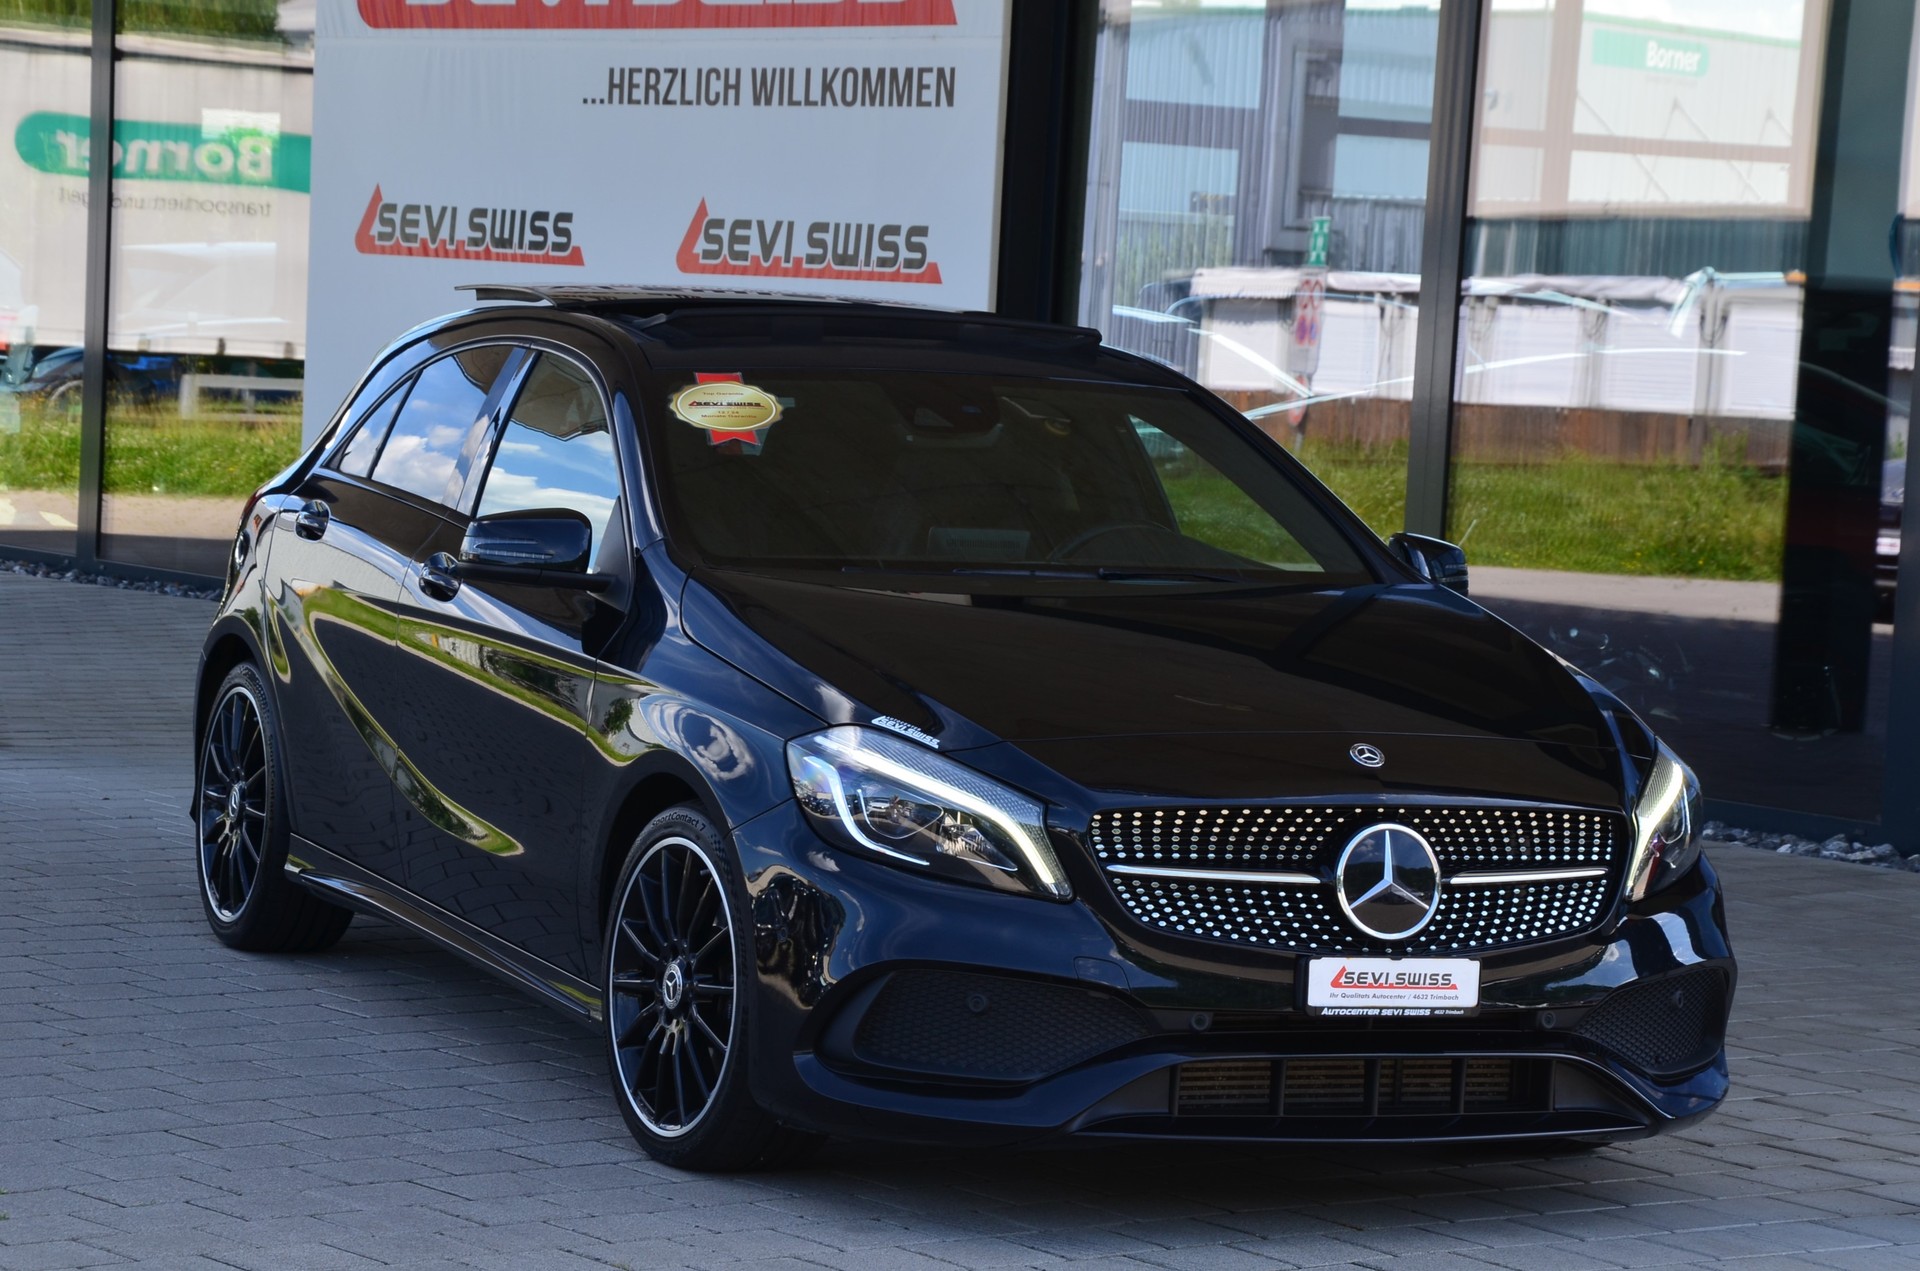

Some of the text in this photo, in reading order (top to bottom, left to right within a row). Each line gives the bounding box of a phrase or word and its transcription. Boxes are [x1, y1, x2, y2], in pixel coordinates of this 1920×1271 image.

[582, 67, 956, 108] ...HERZLICH WILLKOMMEN
[377, 203, 573, 253] SEVI SWISS
[701, 218, 929, 270] SEVI SWISS
[880, 718, 941, 746] SEVI SWISS
[651, 812, 706, 832] SportContact 7
[1343, 971, 1453, 986] SEVI SWISS
[1380, 1008, 1403, 1016] SEVI
[1403, 1008, 1431, 1016] SWISS
